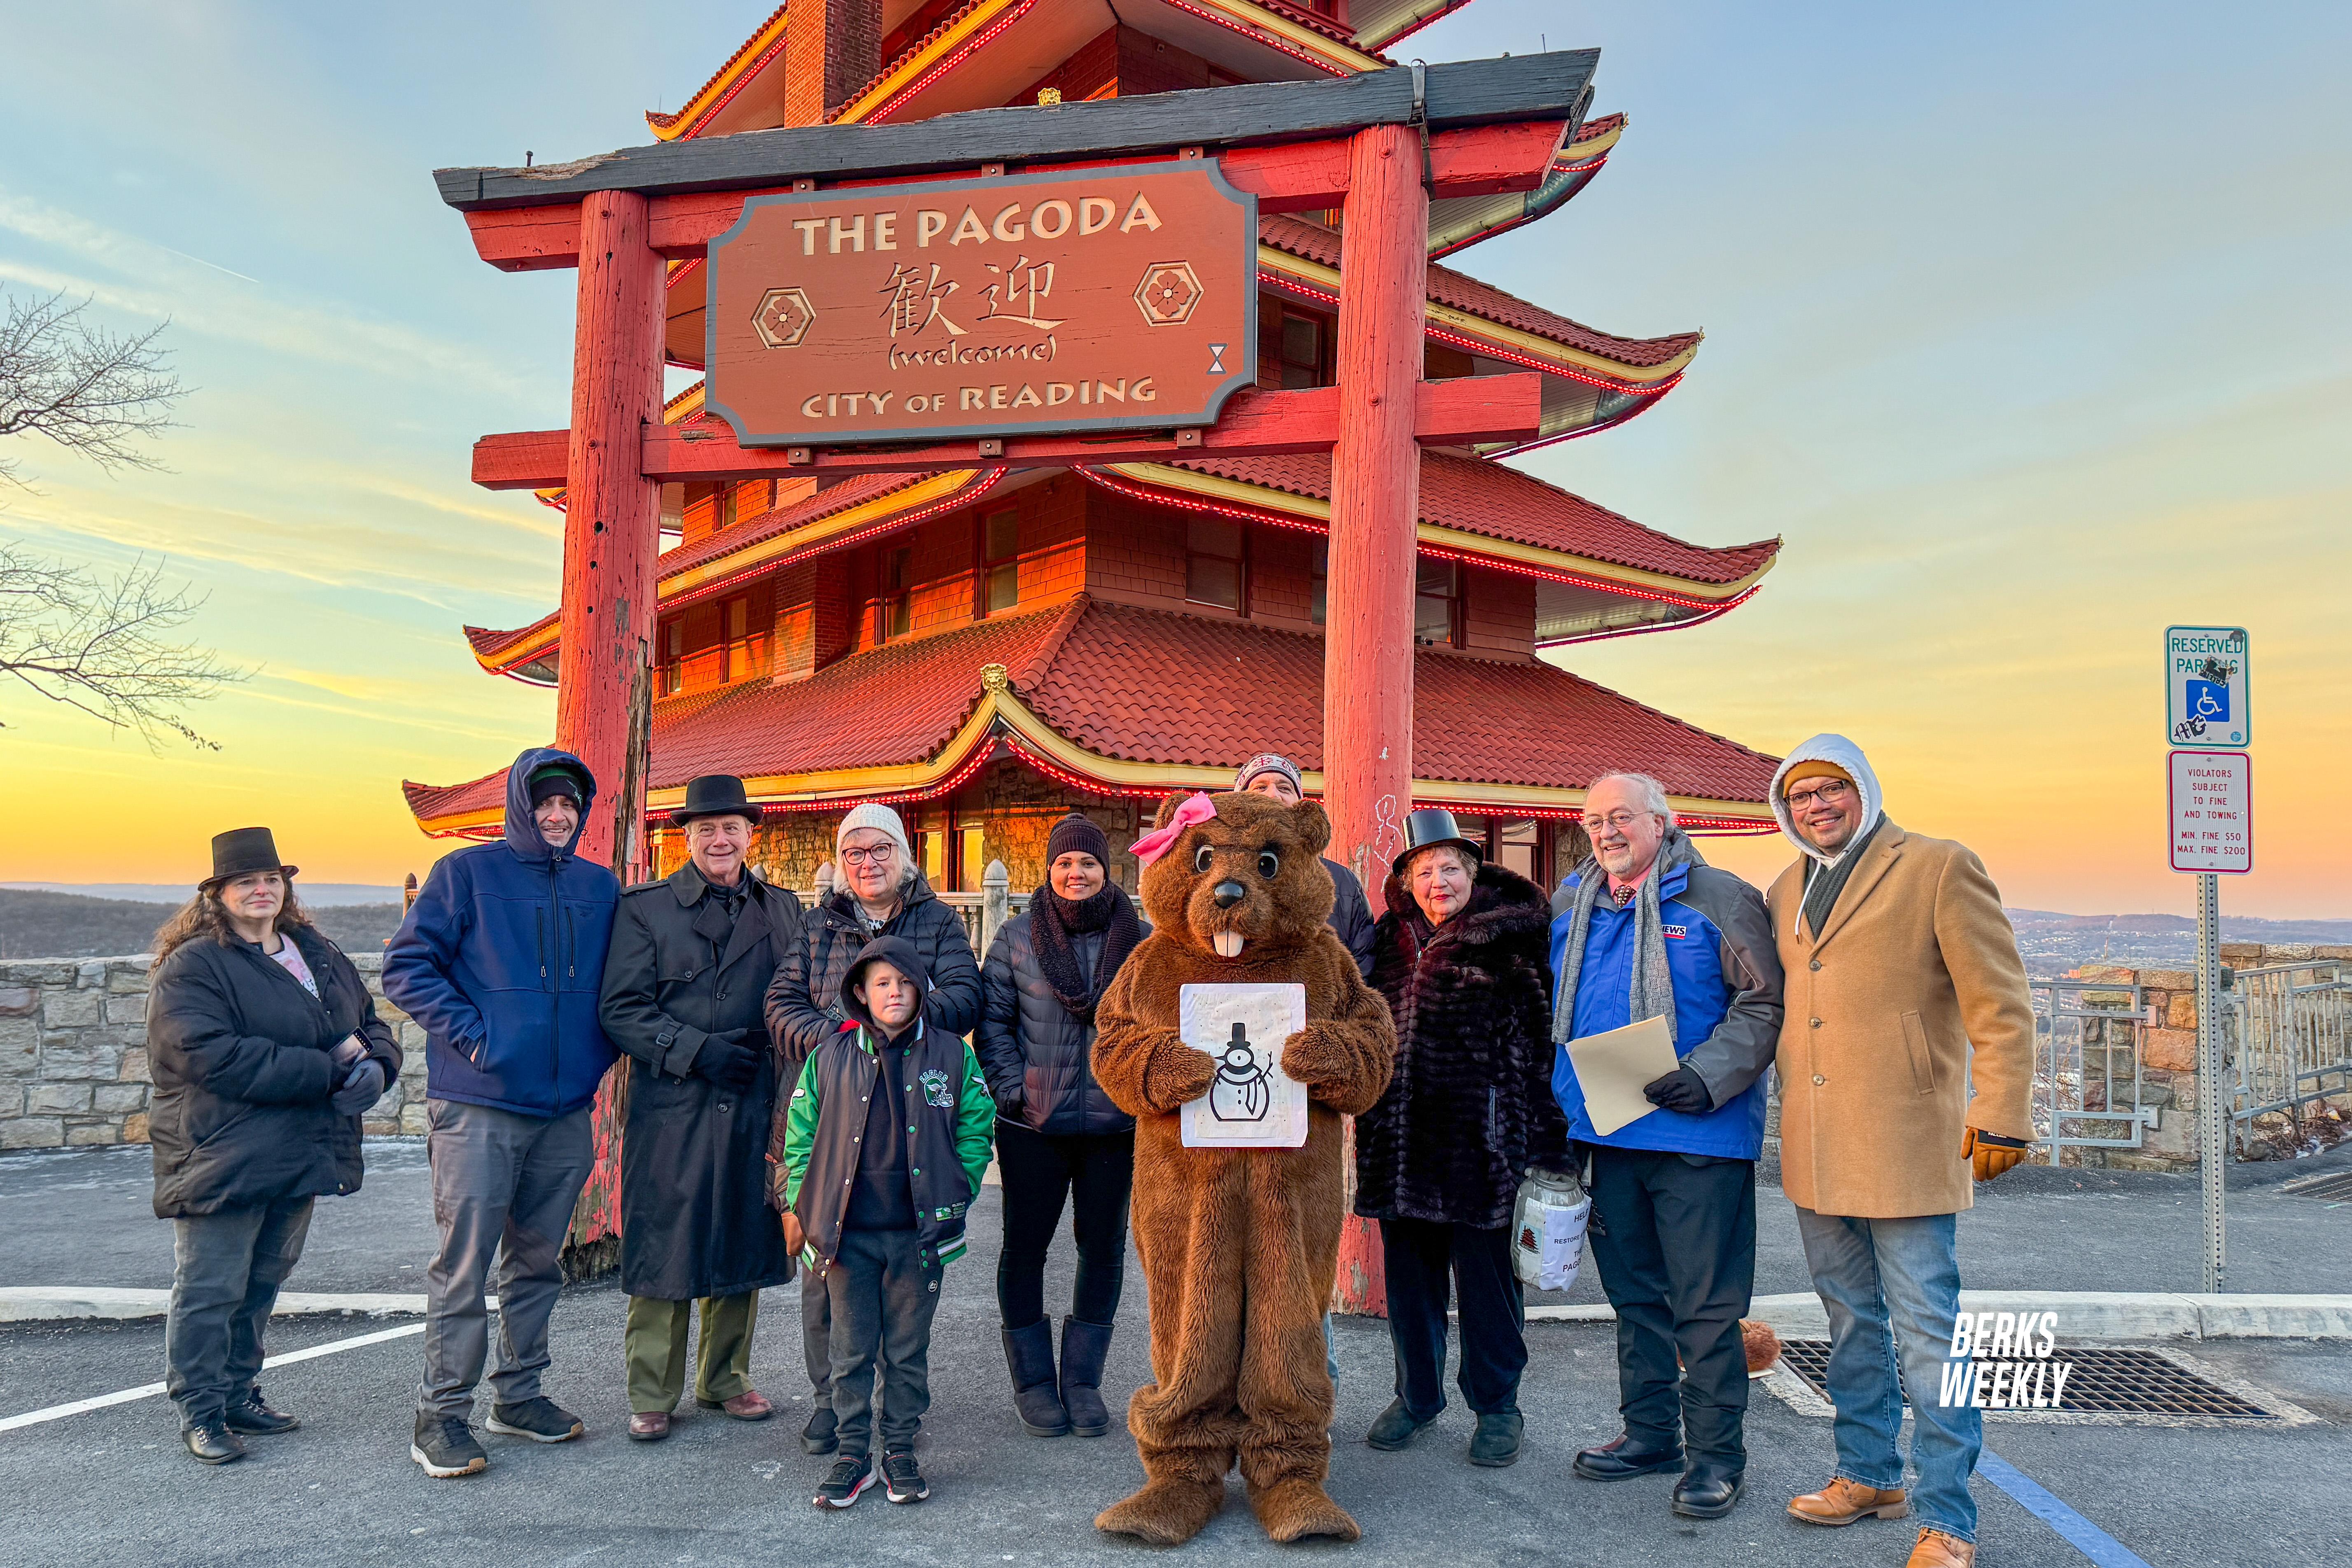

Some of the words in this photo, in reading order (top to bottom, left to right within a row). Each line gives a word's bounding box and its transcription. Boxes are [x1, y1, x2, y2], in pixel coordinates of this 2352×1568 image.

[792, 211, 897, 255] THE
[917, 190, 1162, 248] PAGODA
[889, 334, 1056, 370] (welcome)
[800, 391, 893, 418] CITY
[905, 394, 945, 413] OF
[959, 376, 1155, 410] READING
[2172, 638, 2243, 653] RESERVED
[2177, 658, 2238, 674] PARG
[2188, 769, 2232, 778] VIOLATORS
[2193, 783, 2227, 791] SUBJECT
[2207, 811, 2237, 819] TOWING
[2182, 831, 2197, 840] MIN.
[2226, 833, 2241, 841] $50
[2177, 845, 2196, 854] MAX.
[2201, 846, 2218, 854] FINE
[2224, 846, 2245, 855] $200
[919, 1069, 949, 1084] EAGLES
[1554, 1234, 1580, 1244] RESTORE
